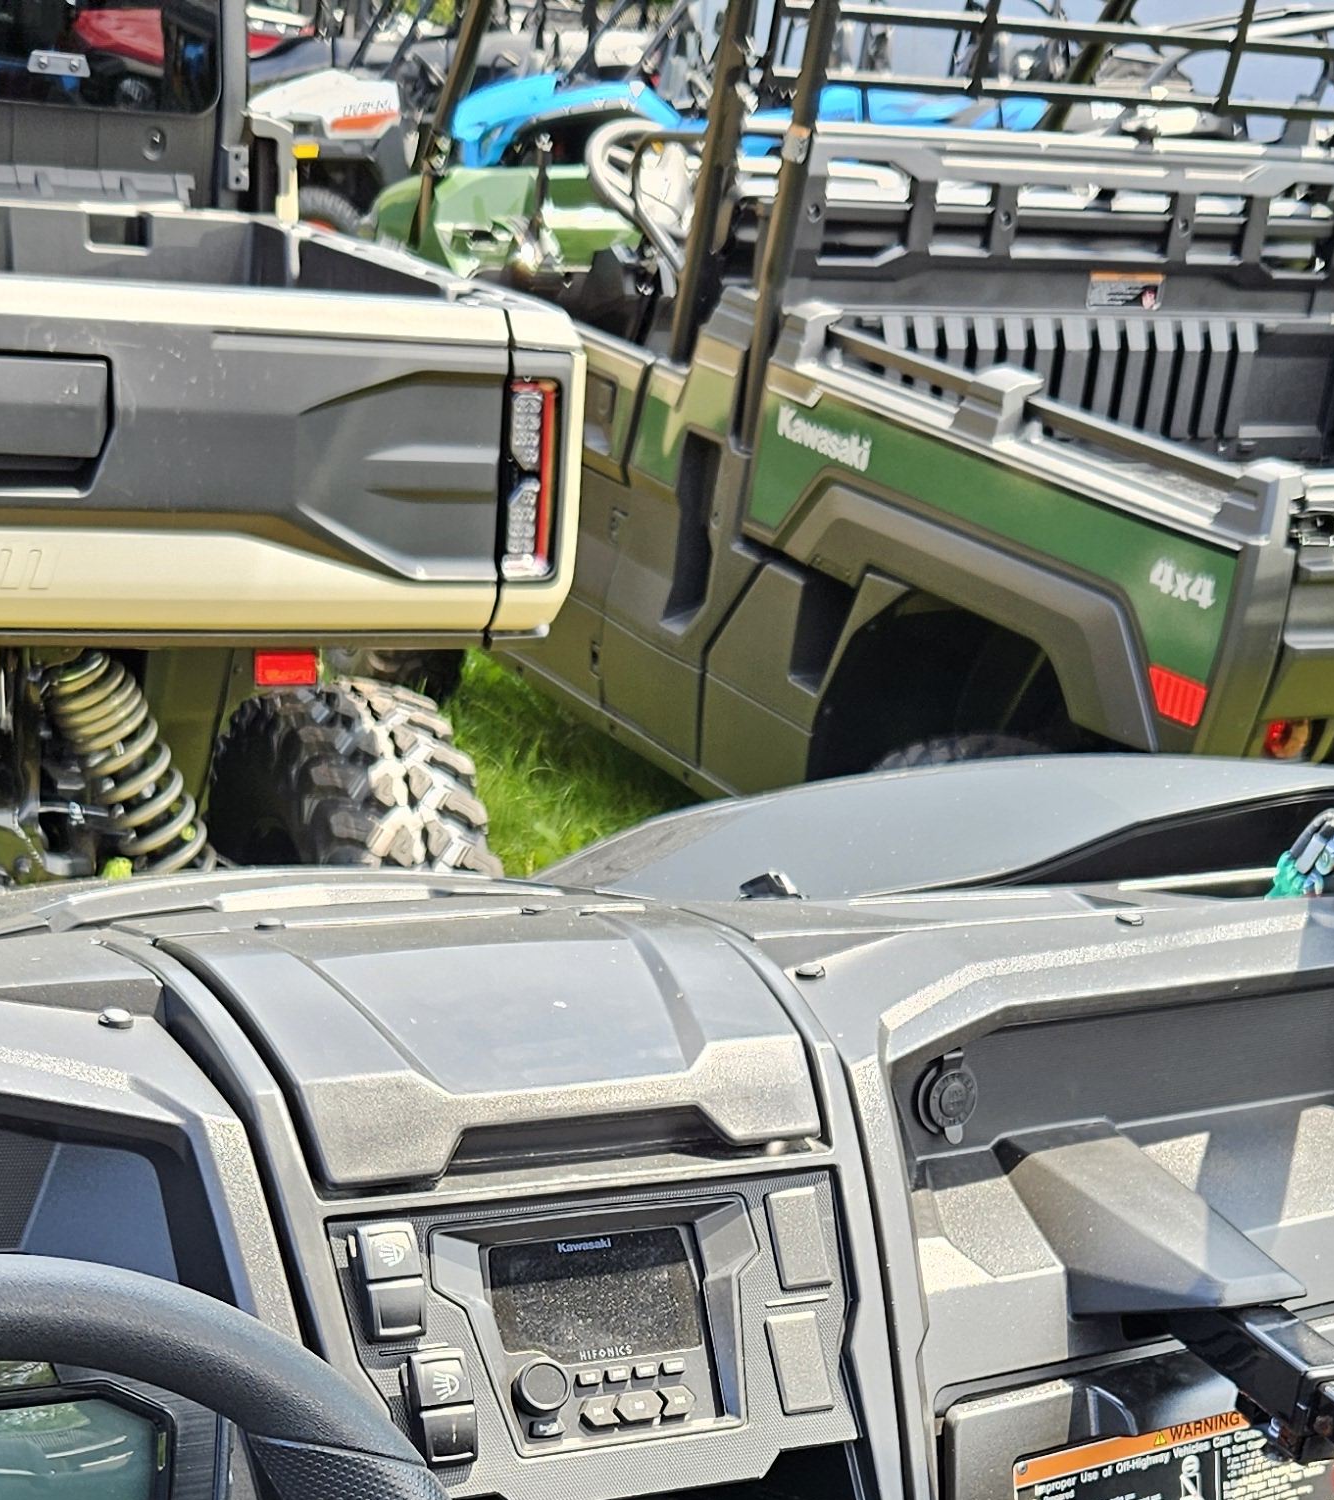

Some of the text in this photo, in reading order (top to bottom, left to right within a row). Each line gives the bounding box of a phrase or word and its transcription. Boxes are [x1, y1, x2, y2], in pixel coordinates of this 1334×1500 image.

[776, 404, 872, 472] Kawasaki
[1149, 557, 1216, 610] 4x4
[557, 1237, 612, 1253] Kawasaki
[579, 1344, 633, 1361] HIFONICS
[1170, 1412, 1240, 1442] WARNING
[1034, 1475, 1077, 1496] Improper
[1080, 1470, 1099, 1484] Use
[1102, 1466, 1114, 1478] of
[1116, 1451, 1171, 1475] Off-Highway
[1173, 1440, 1212, 1459] Vehicles
[1213, 1434, 1233, 1448] Can
